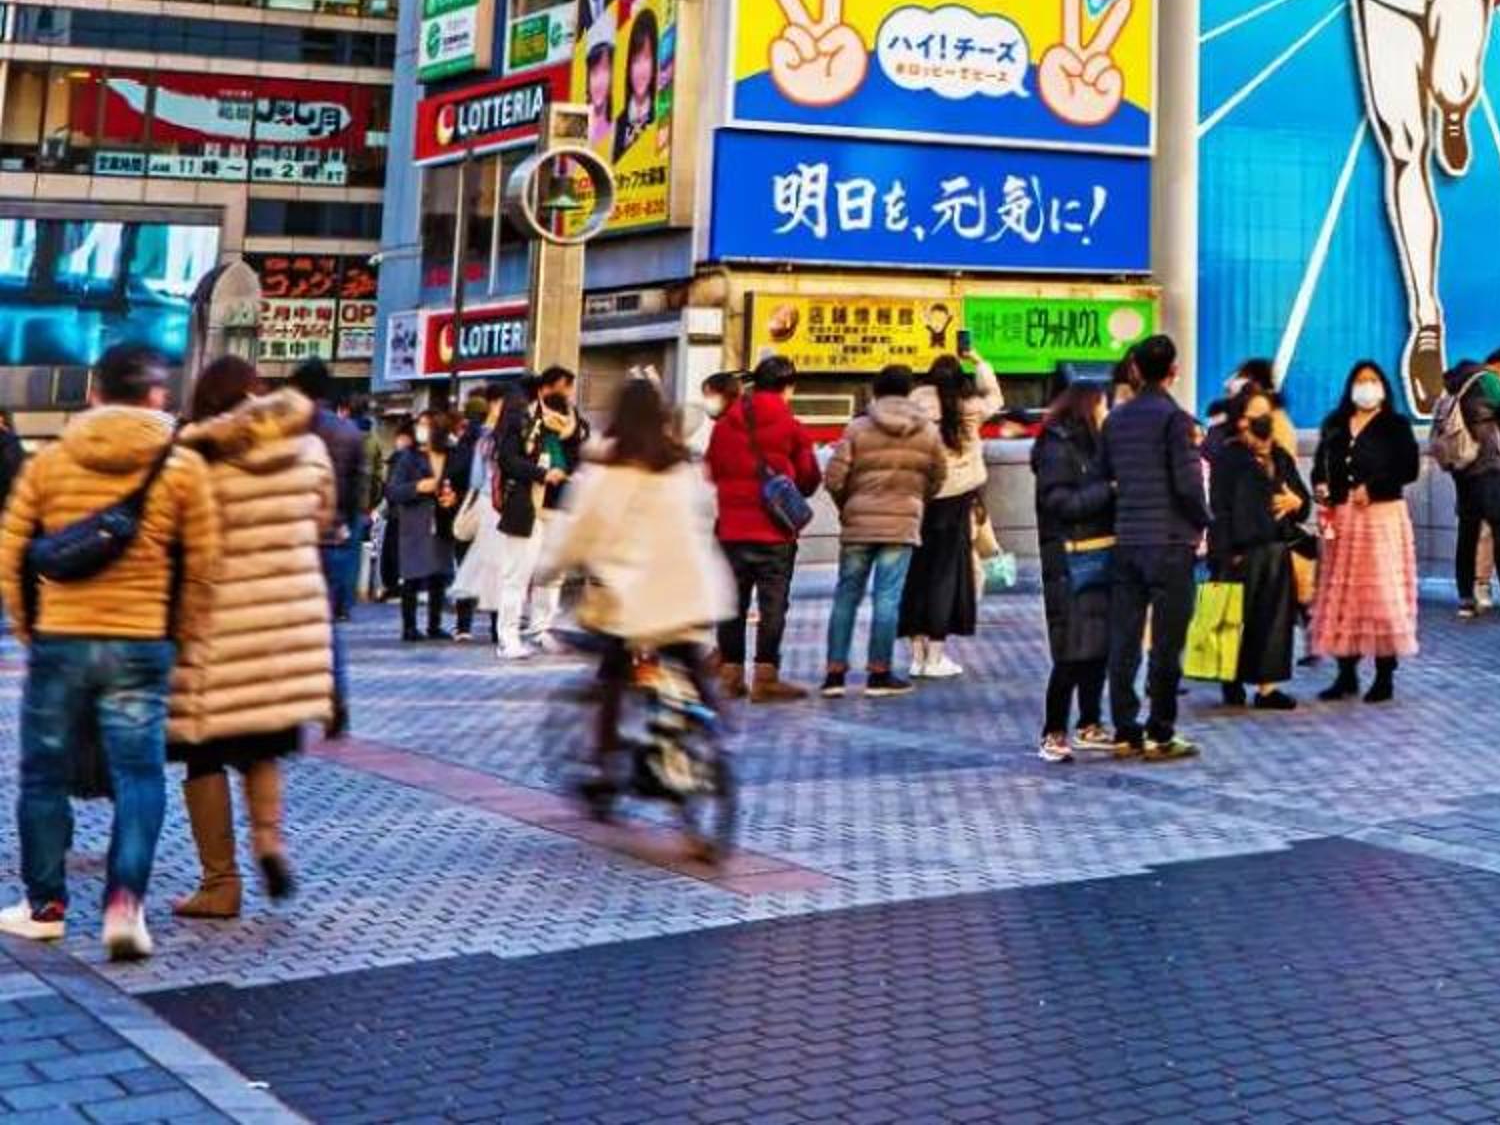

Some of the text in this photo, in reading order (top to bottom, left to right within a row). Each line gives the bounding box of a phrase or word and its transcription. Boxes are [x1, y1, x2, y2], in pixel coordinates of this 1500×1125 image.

[456, 84, 545, 133] LOTTERIA
[770, 161, 1108, 246] 明日を、元気に!
